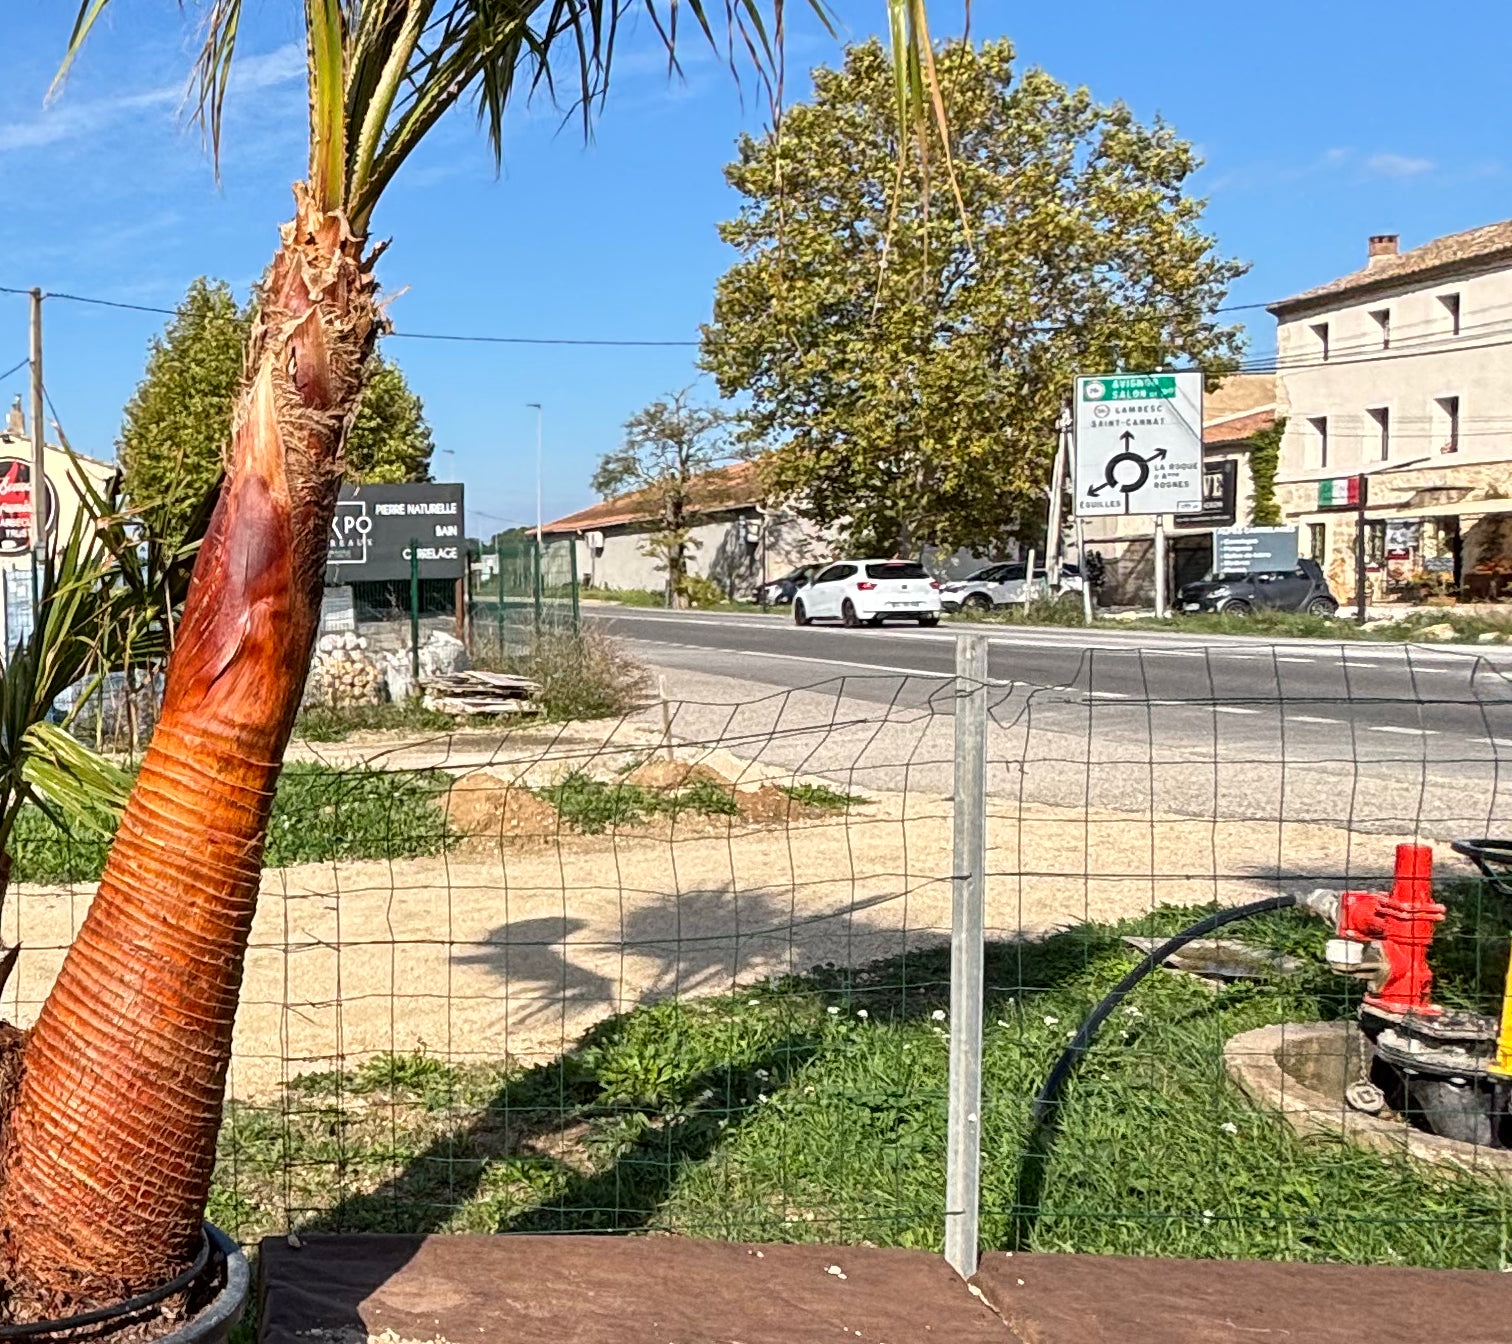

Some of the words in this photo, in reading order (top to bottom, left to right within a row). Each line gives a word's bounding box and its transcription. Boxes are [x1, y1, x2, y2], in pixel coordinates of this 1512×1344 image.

[1112, 388, 1147, 400] SALON
[1115, 404, 1163, 414] LAMBESC
[1091, 417, 1165, 428] SAINT-CANNAT
[1203, 474, 1224, 498] VE
[374, 503, 406, 515] PIERRE
[407, 502, 457, 515] NATURELLE
[434, 524, 458, 536] BAIN
[329, 538, 374, 547] REAUX
[402, 547, 458, 560] CRRELAGE
